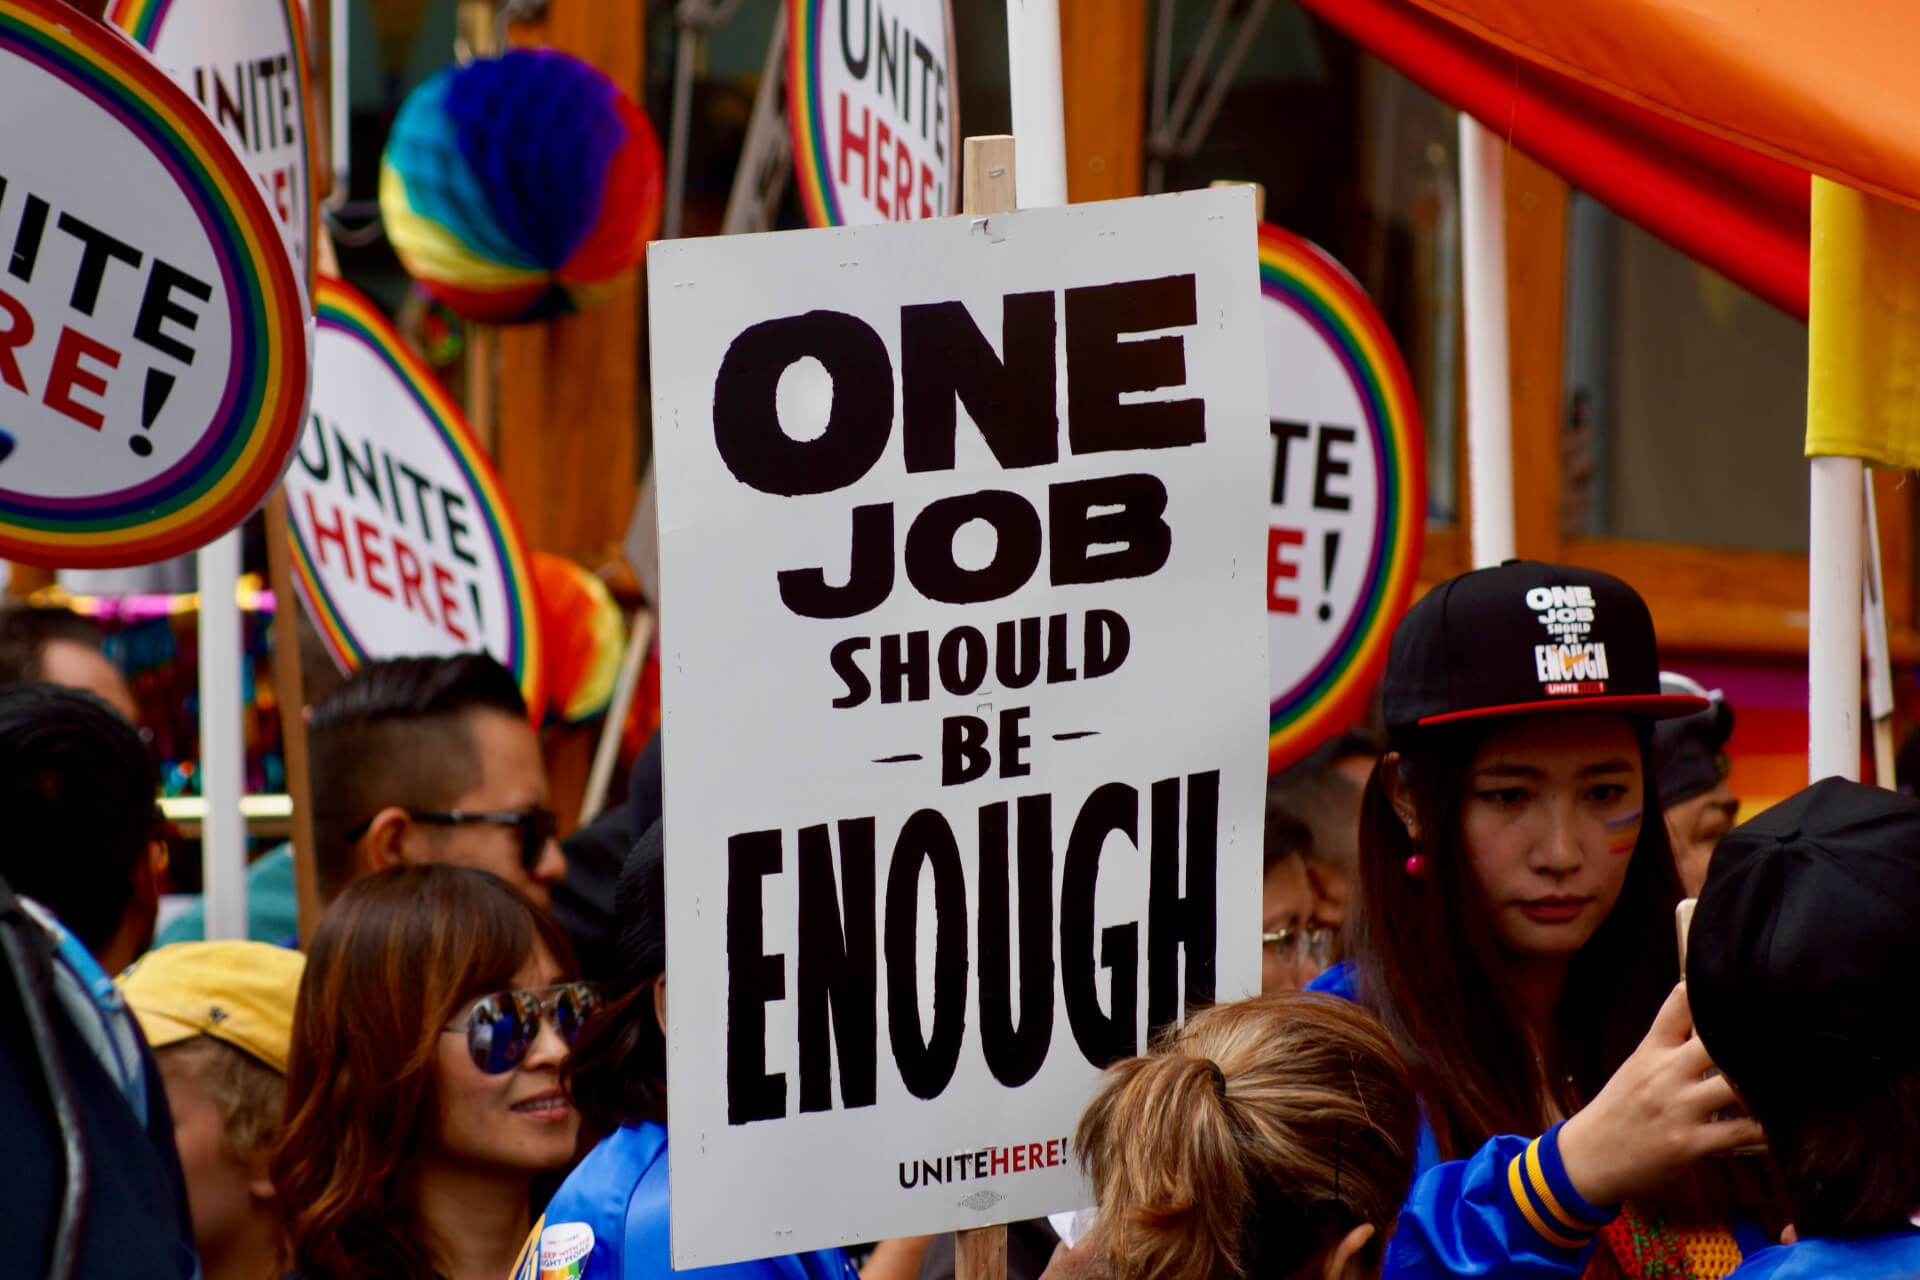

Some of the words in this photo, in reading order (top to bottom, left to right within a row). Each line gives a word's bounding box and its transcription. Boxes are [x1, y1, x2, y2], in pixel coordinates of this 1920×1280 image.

[0, 175, 213, 366] ITE
[712, 273, 1206, 497] ONE
[777, 473, 1171, 619] JOB
[1526, 585, 1596, 611] ONE
[1538, 607, 1595, 624] JOB
[1547, 622, 1591, 635] SHOULD
[830, 609, 1130, 709] SHOULD
[1535, 641, 1609, 682] ENOUGH
[1564, 633, 1579, 644] BE
[942, 706, 1031, 786] BE
[727, 769, 1220, 1126] ENOUGH
